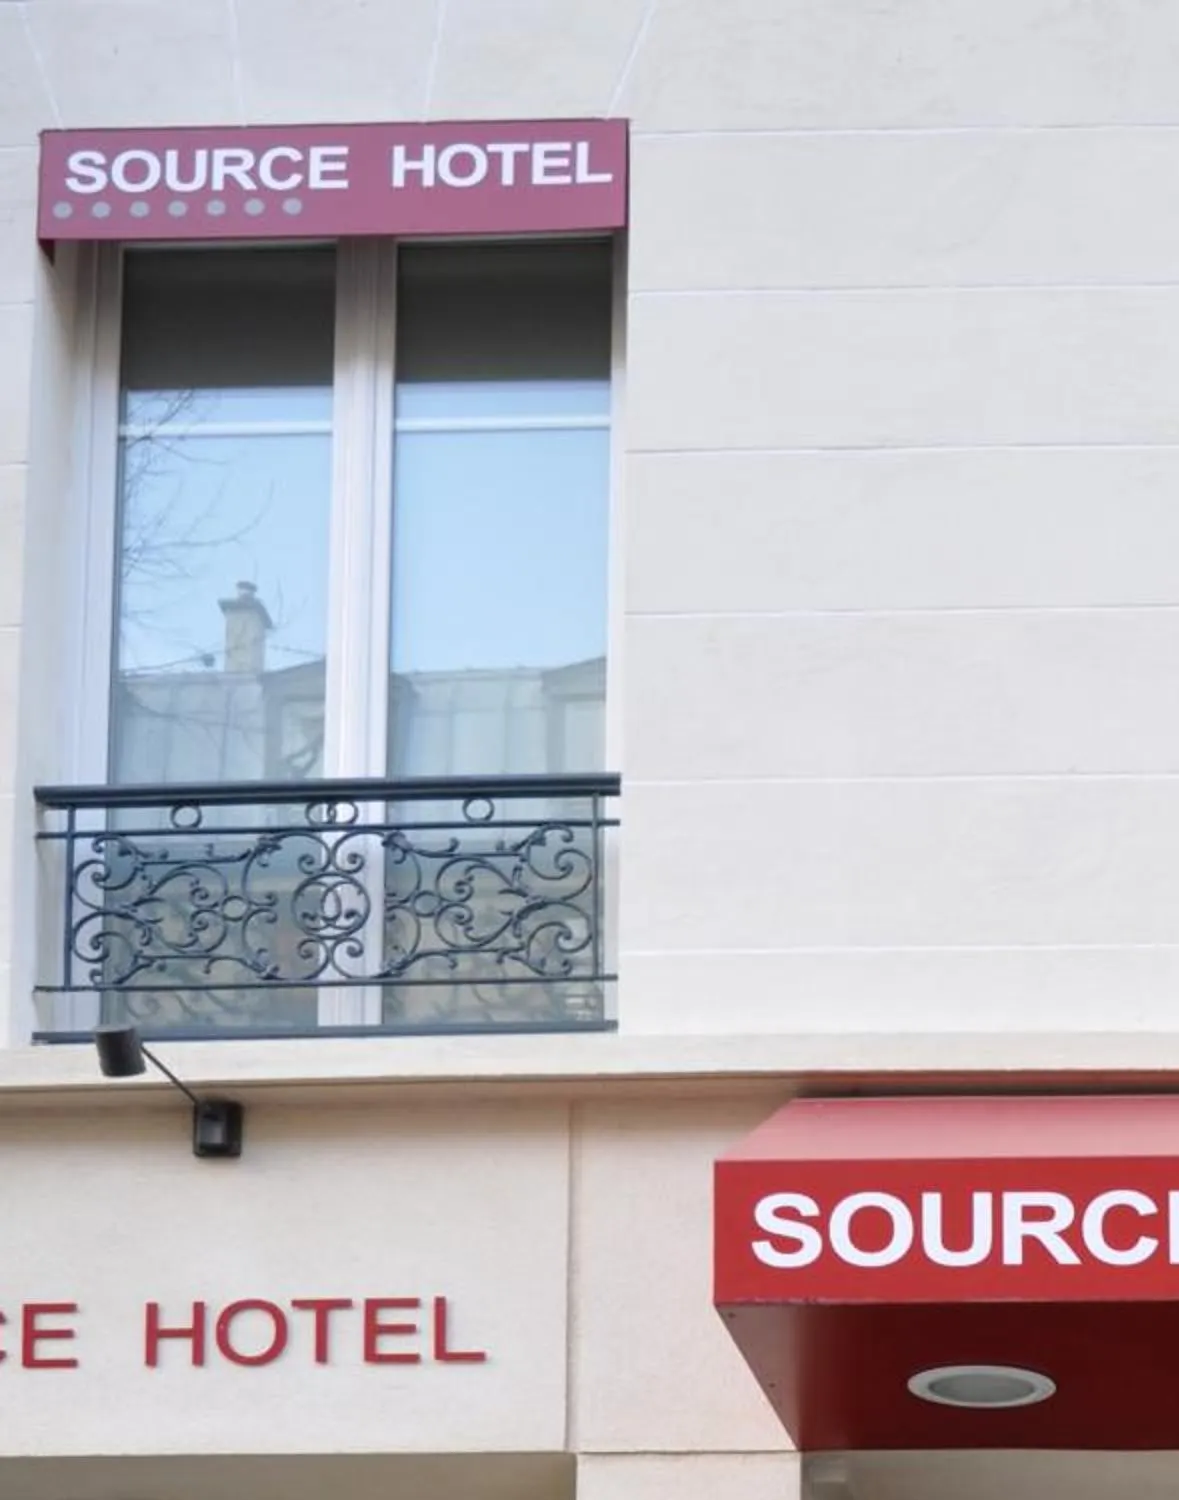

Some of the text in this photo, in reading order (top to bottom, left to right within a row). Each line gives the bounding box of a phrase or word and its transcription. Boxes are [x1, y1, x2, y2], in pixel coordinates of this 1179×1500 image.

[65, 141, 613, 194] SOURCE HOTEL
[0, 1296, 487, 1369] E HOTEL
